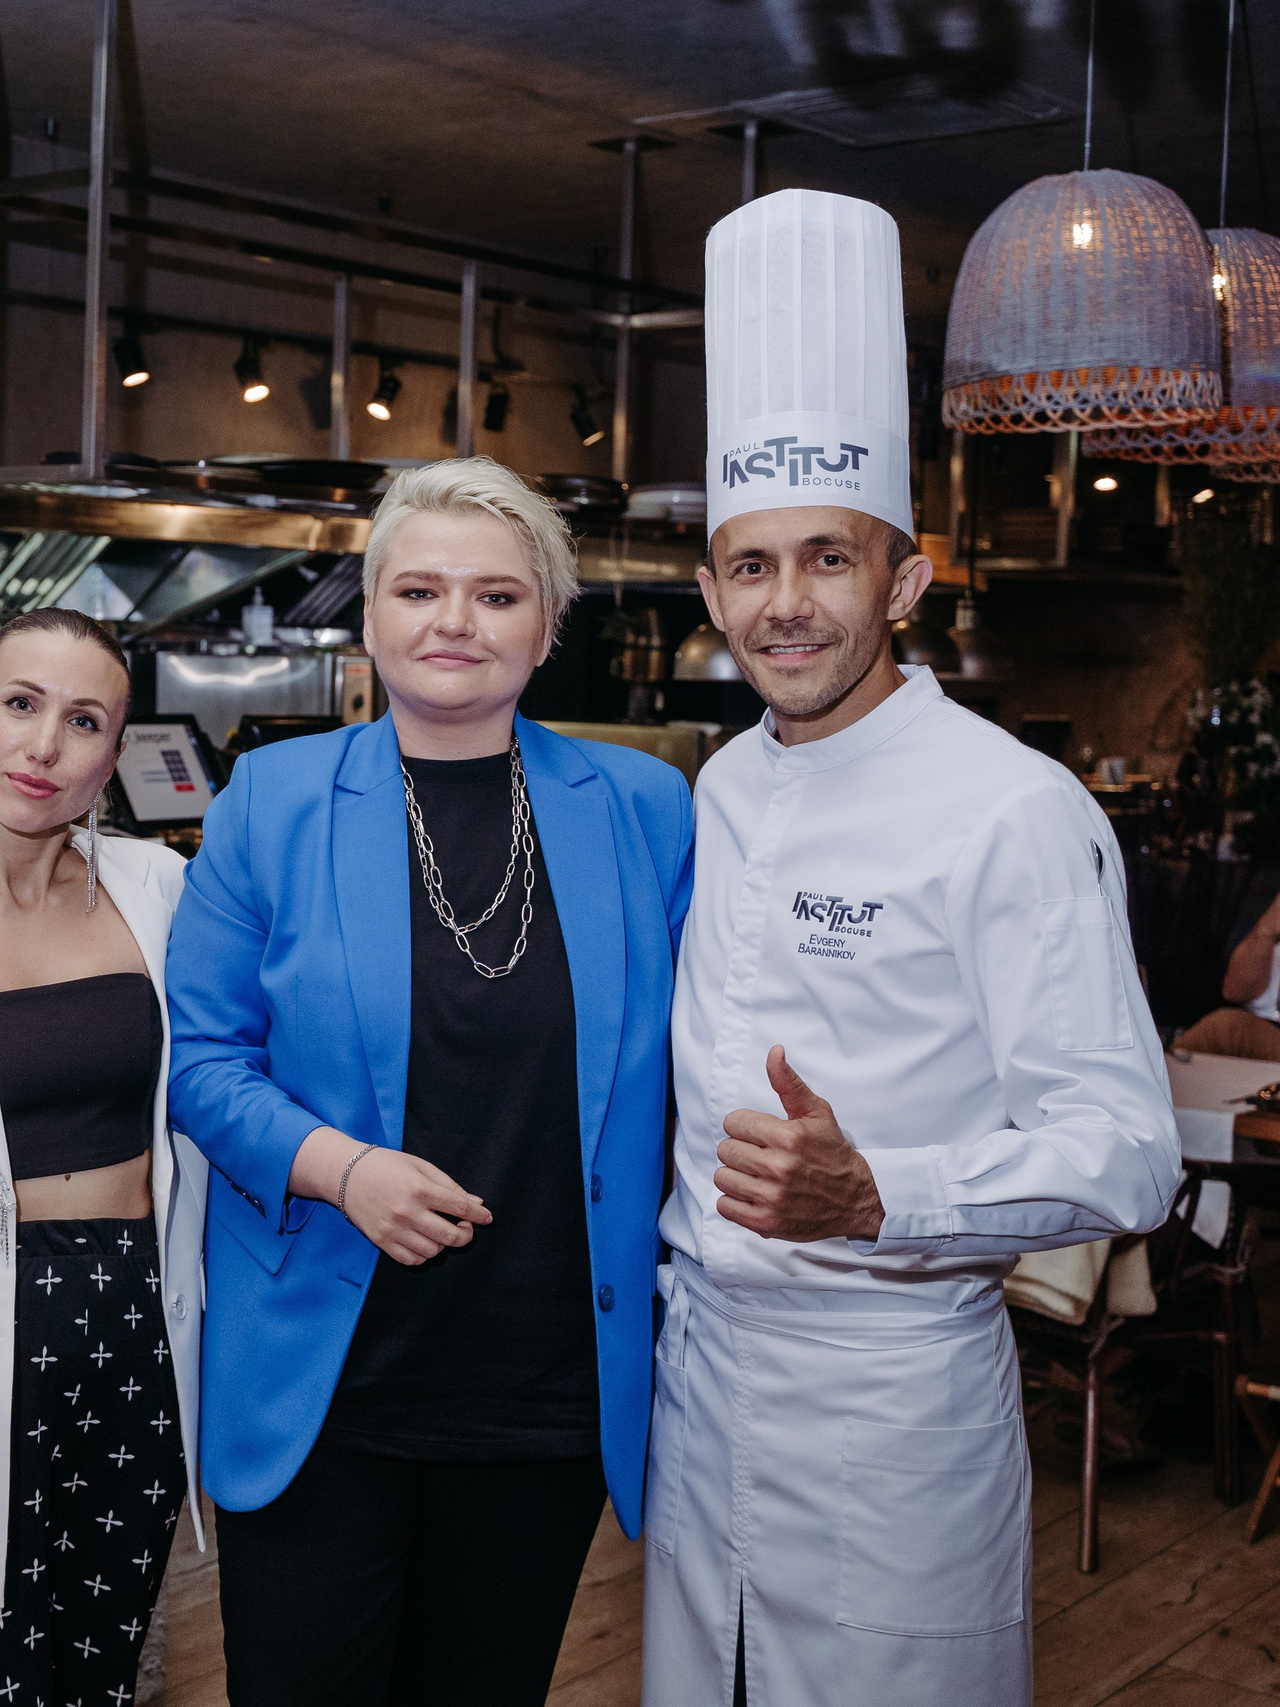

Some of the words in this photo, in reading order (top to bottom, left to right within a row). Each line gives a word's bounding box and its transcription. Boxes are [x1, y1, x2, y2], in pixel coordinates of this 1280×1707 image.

[729, 441, 761, 459] PAUL
[722, 435, 869, 490] INSTITUT
[802, 476, 861, 491] BOCUSE
[802, 892, 824, 902] PAUL
[792, 891, 884, 932] INSTITUT
[834, 926, 873, 938] BOCUSE
